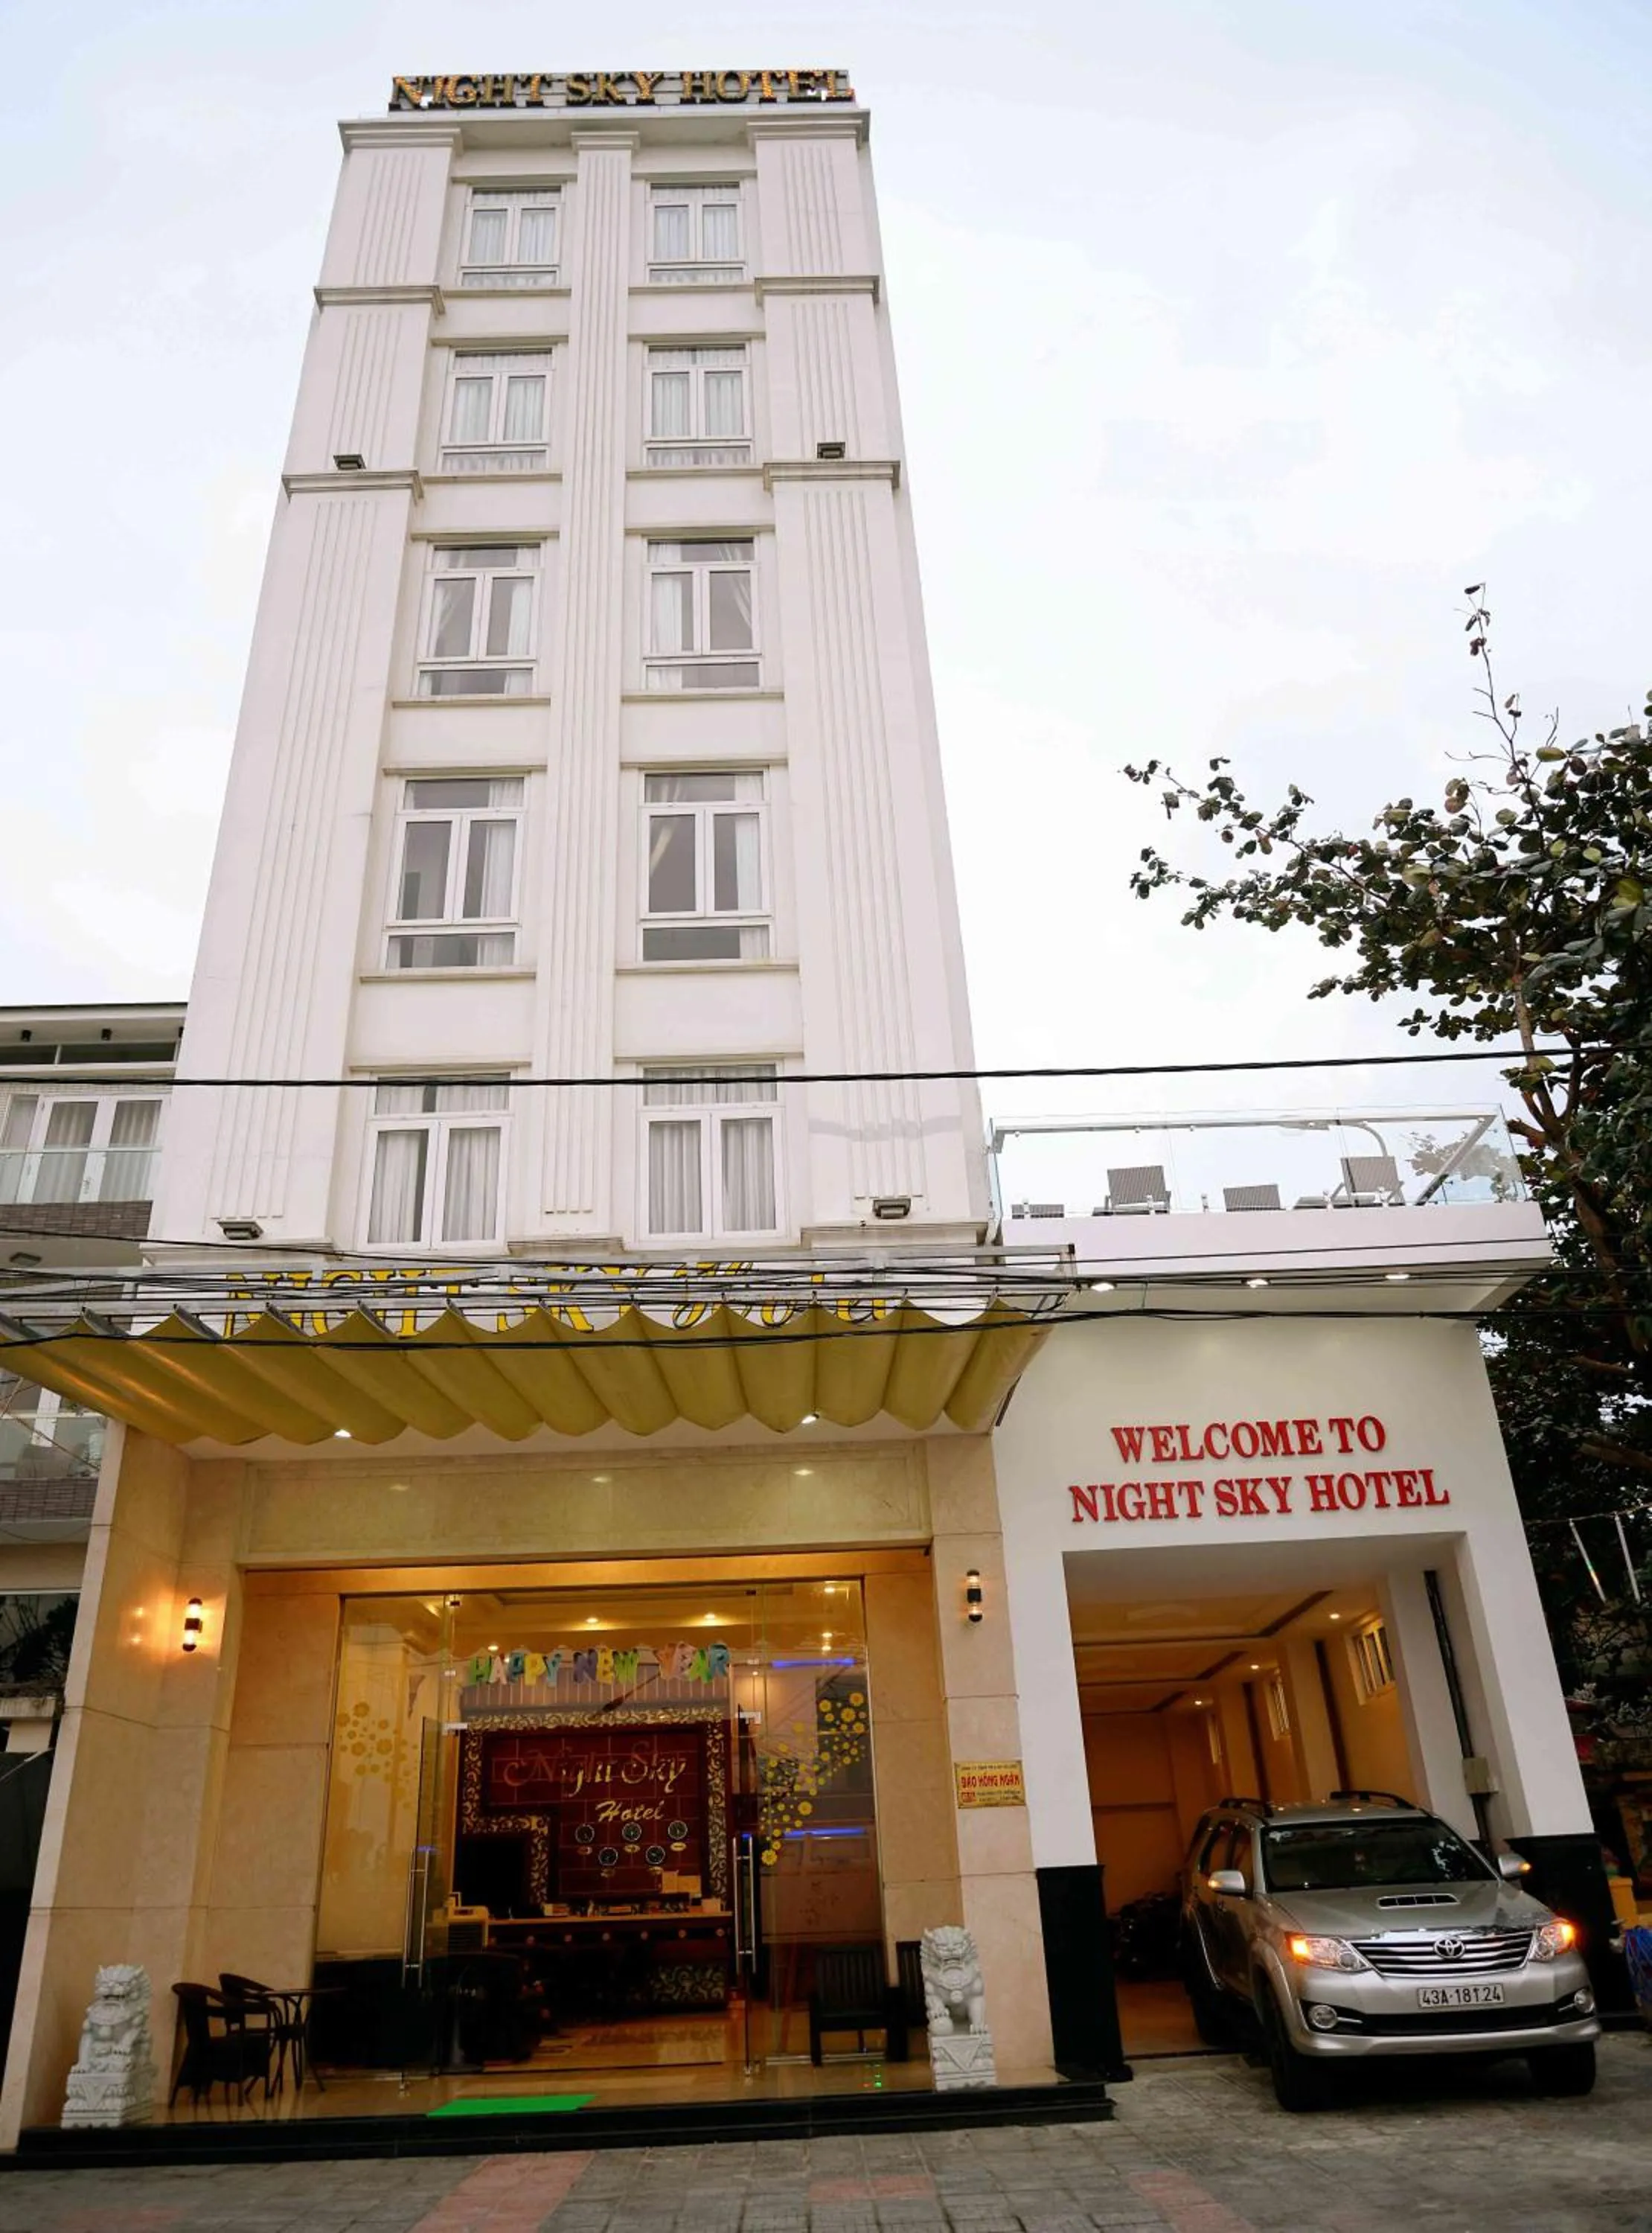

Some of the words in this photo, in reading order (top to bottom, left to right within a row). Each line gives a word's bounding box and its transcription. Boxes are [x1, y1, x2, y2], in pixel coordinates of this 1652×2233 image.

[388, 74, 562, 110] NIGHT
[565, 72, 673, 106] SKY
[679, 70, 855, 103] HOTEL
[1110, 1418, 1323, 1464] WELCOME
[1328, 1415, 1386, 1454] TO
[1068, 1480, 1206, 1523] NIGHT
[1213, 1475, 1293, 1517] SKY
[1304, 1469, 1450, 1512] HOTEL
[470, 1649, 562, 1687] HAPPY
[573, 1646, 641, 1685] NEW
[655, 1641, 731, 1684] YEAR
[621, 1740, 688, 1794] Sky
[595, 1799, 665, 1822] Hotel
